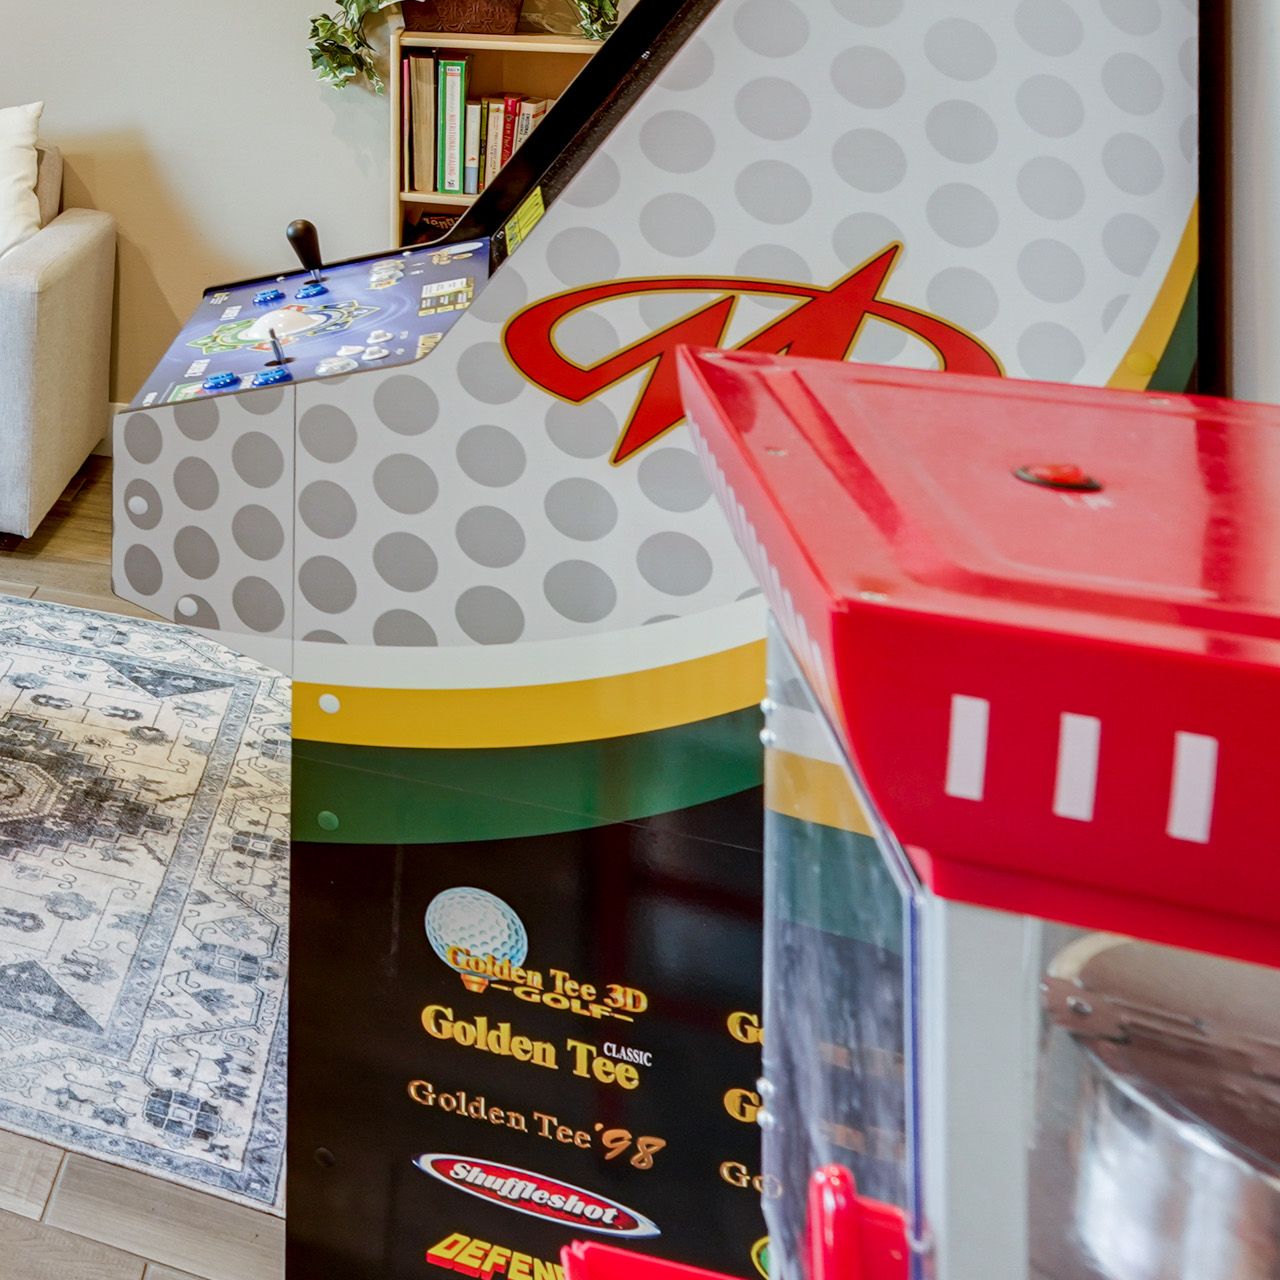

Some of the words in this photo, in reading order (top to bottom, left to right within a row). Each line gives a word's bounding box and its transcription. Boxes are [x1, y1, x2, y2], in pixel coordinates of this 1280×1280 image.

[446, 946, 543, 991] Golden
[549, 968, 597, 1002] Tee
[603, 984, 649, 1014] 3D
[421, 1004, 559, 1070] Golden
[567, 1039, 640, 1090] Tee
[603, 1041, 653, 1068] CLASSIC
[408, 1079, 529, 1134] Golden
[534, 1111, 593, 1150] Tee
[449, 1162, 619, 1225] Shuffleshot
